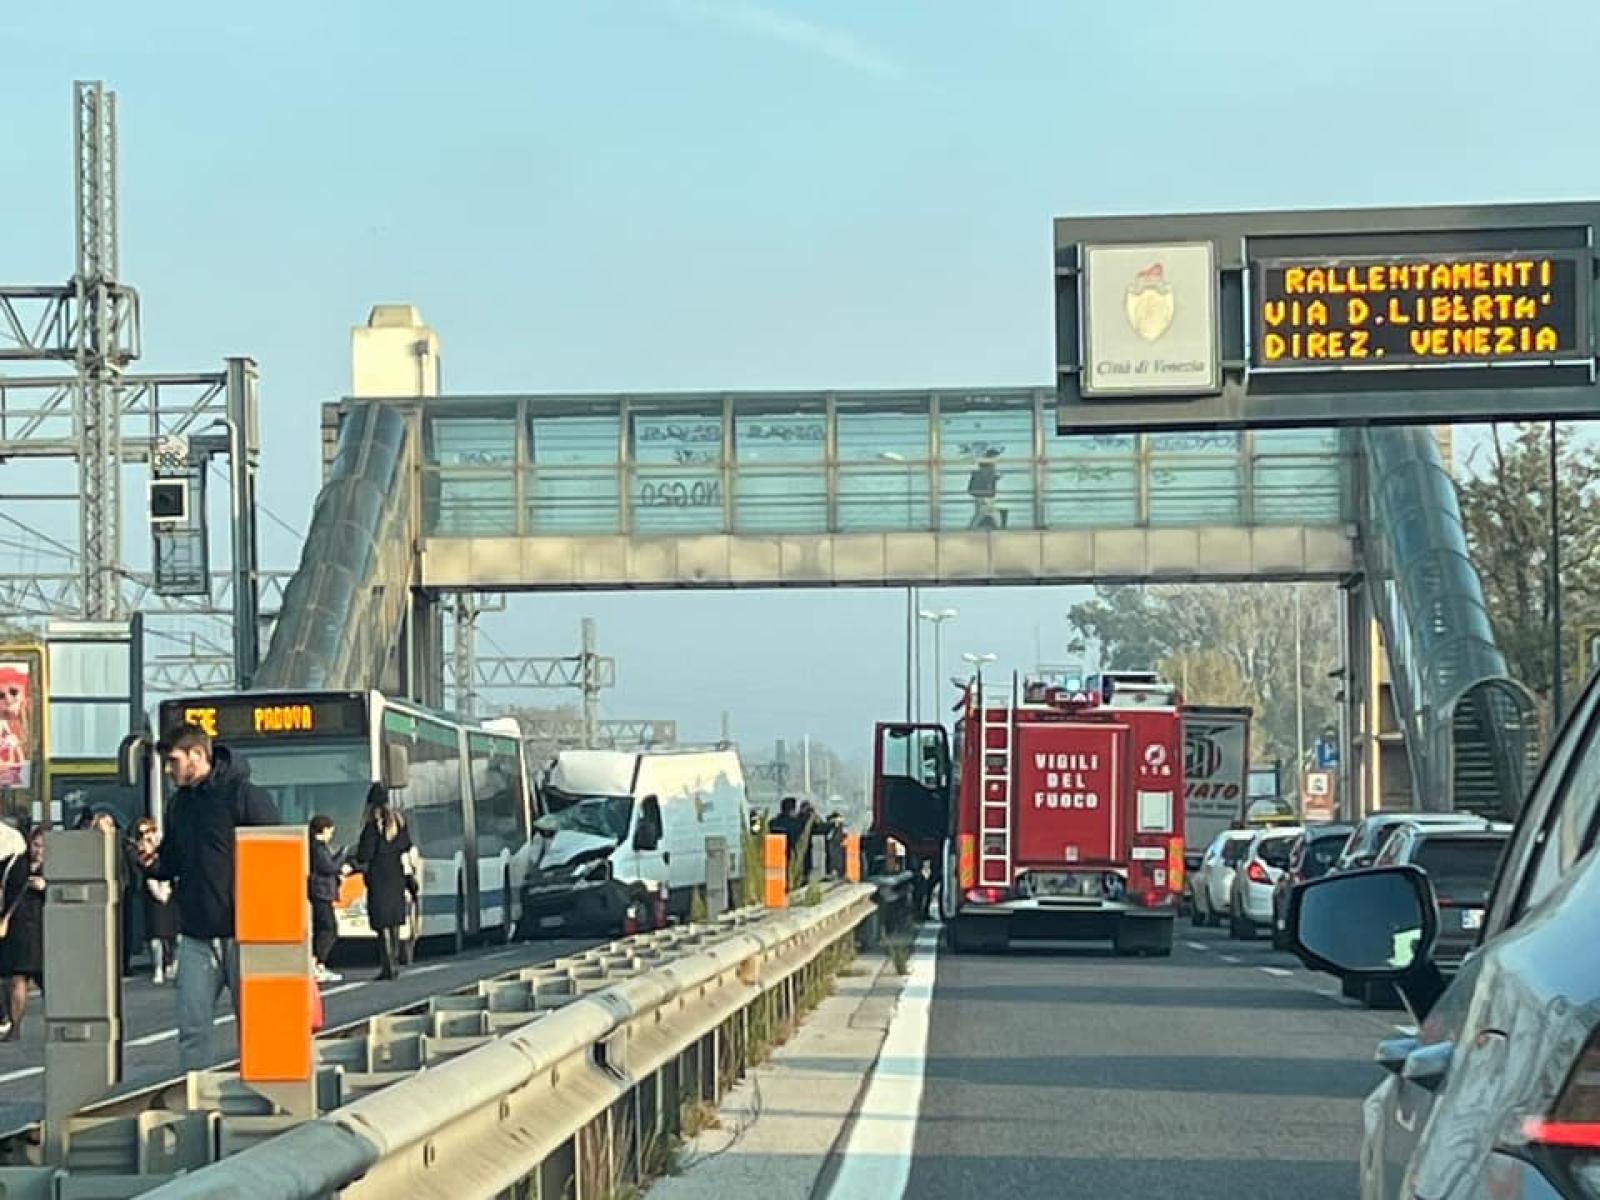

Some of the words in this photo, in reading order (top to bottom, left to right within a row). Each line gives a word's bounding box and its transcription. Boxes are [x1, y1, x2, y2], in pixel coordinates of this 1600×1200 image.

[1284, 259, 1551, 294] RALLENTAMENTI
[1264, 299, 1327, 326] VIA
[1264, 331, 1384, 359] DIREZ.
[1410, 325, 1557, 356] VENEZIA
[1134, 358, 1149, 374] di
[1152, 357, 1206, 374] Venezia
[254, 704, 313, 731] PADOVA
[1034, 752, 1099, 771] VIGILI
[1046, 772, 1086, 789] DEL
[1034, 791, 1098, 809] FUOCO
